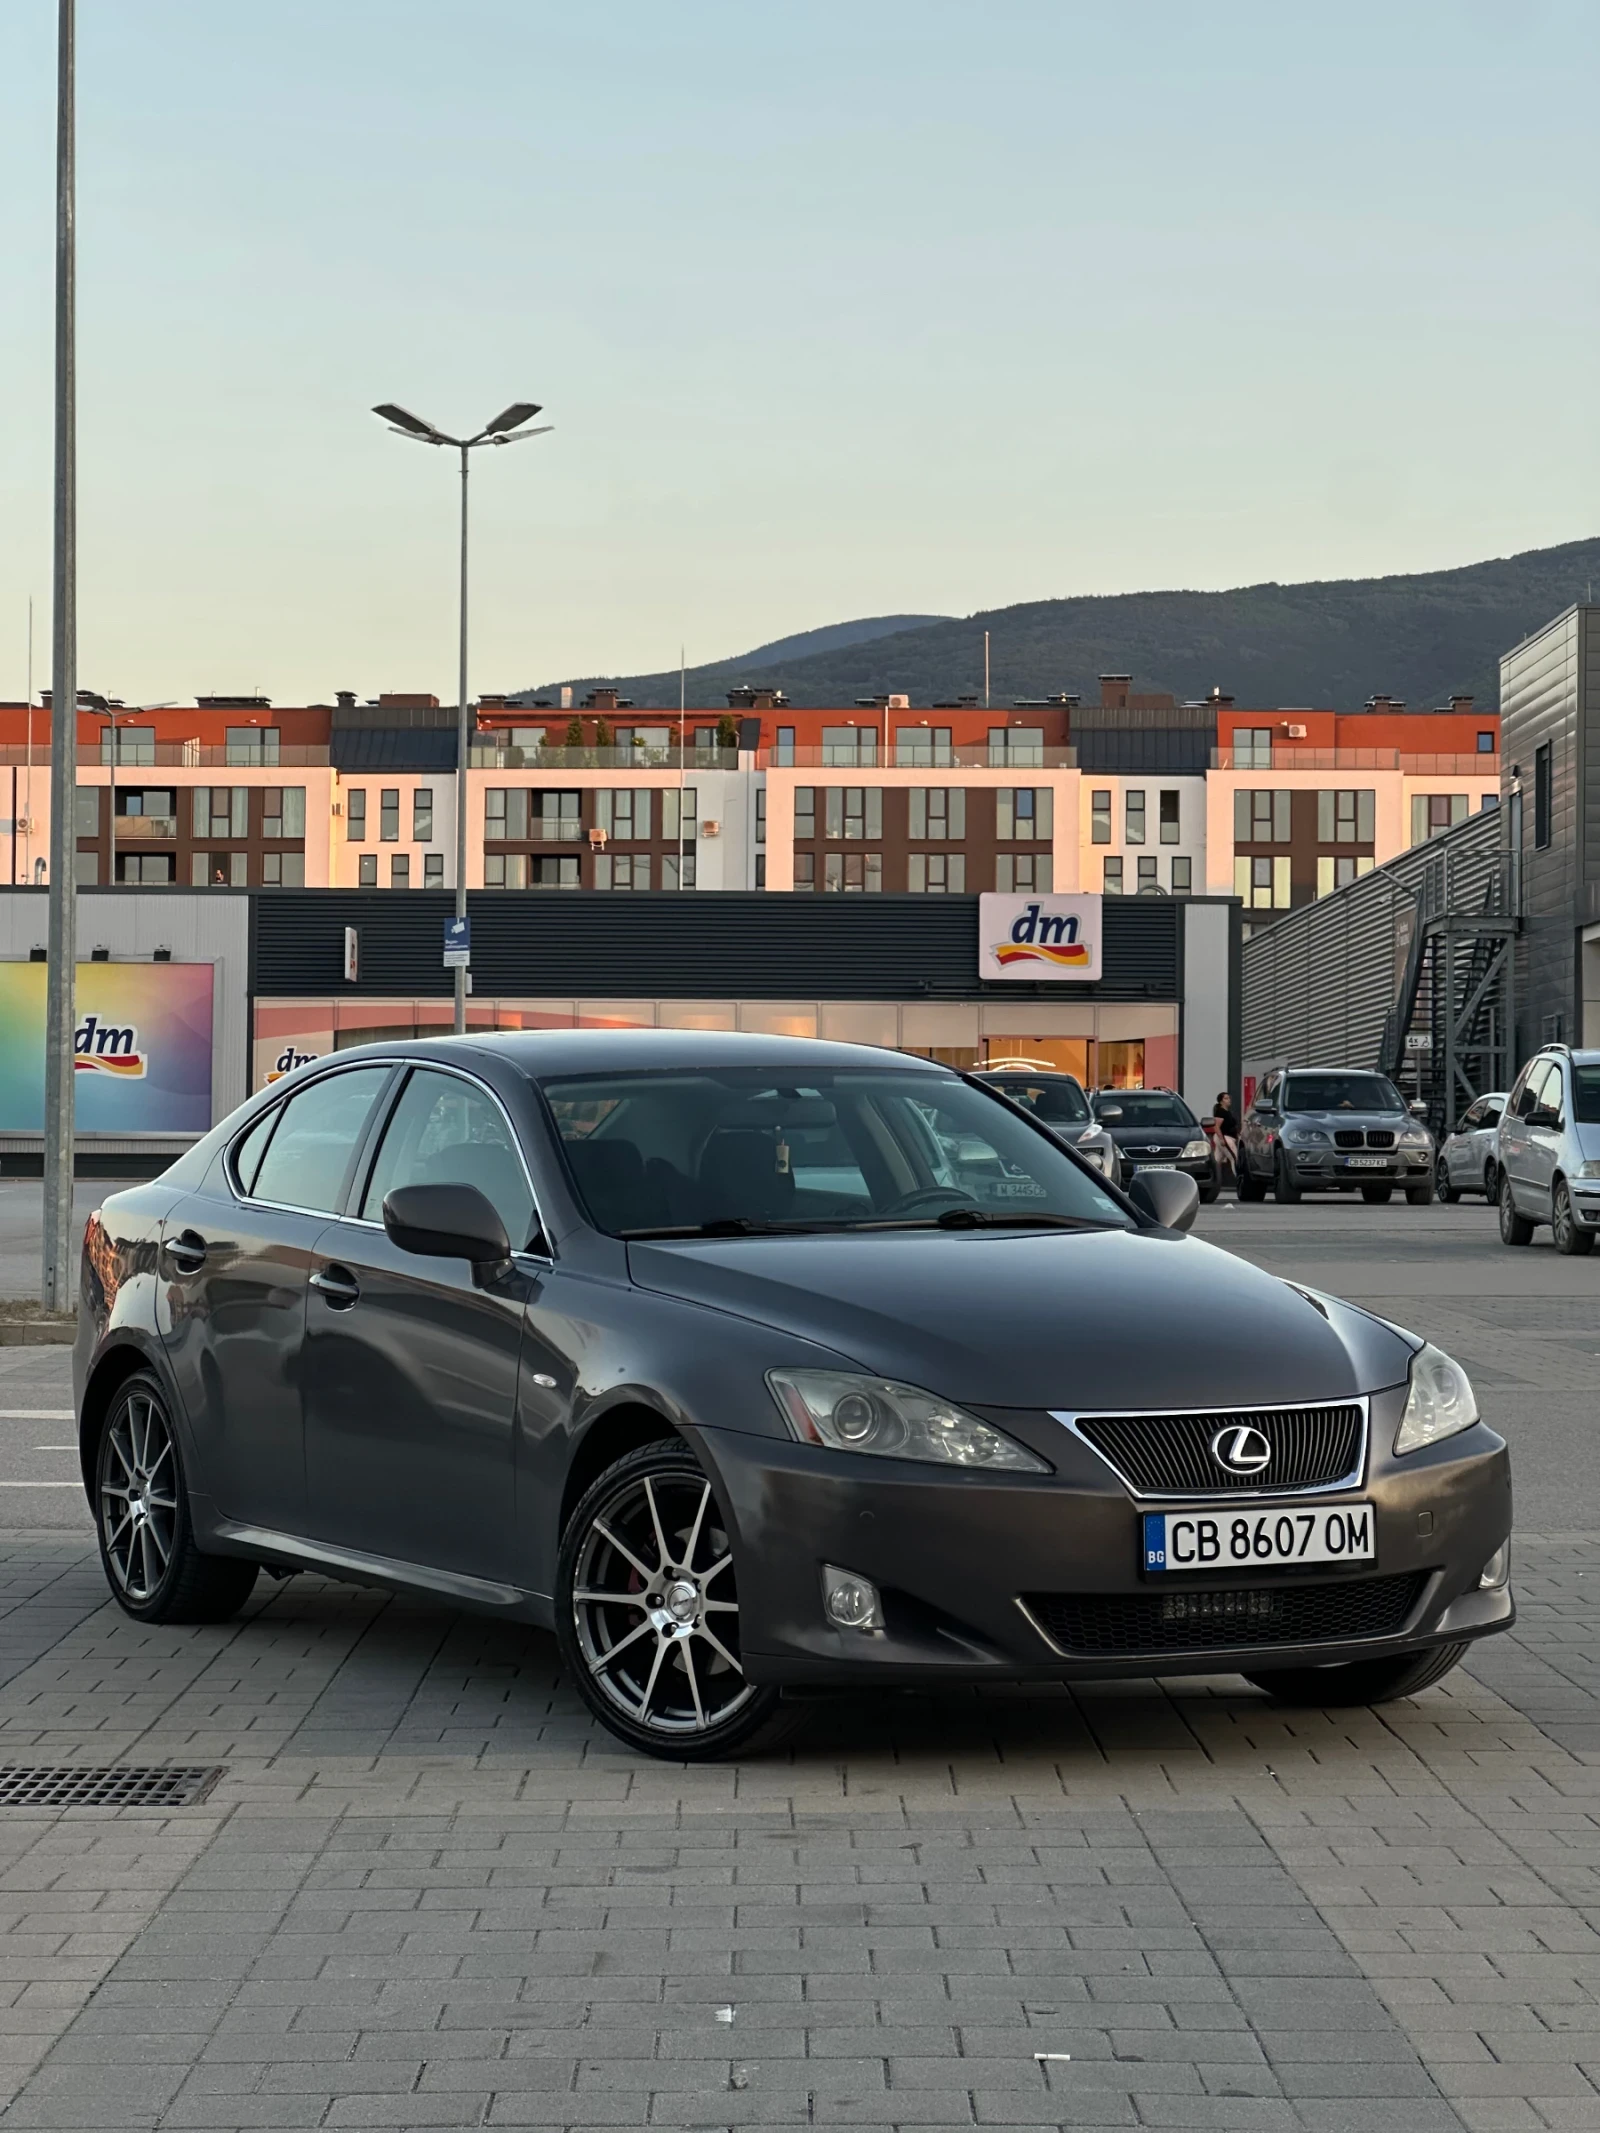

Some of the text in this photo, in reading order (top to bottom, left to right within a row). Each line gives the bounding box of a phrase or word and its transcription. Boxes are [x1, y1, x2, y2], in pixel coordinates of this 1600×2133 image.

[1012, 905, 1078, 943] dm
[75, 1018, 133, 1053] dm
[1172, 1512, 1369, 1562] CB 8607 OM
[1148, 1551, 1164, 1563] BG
